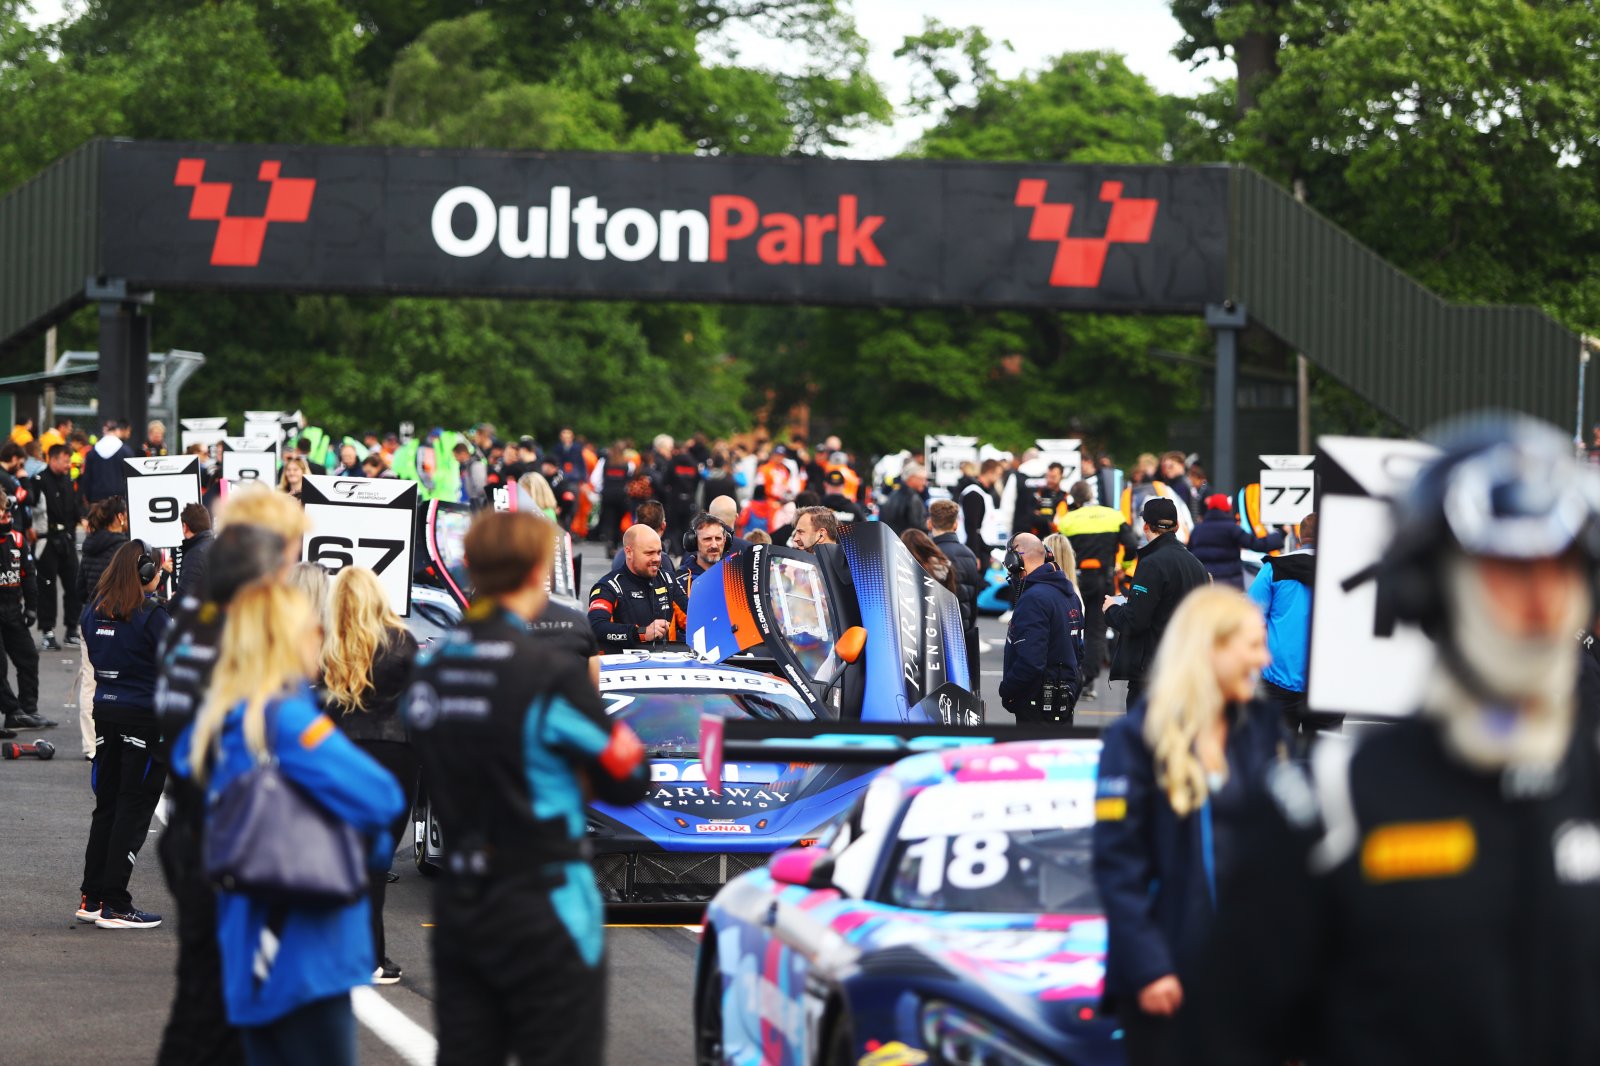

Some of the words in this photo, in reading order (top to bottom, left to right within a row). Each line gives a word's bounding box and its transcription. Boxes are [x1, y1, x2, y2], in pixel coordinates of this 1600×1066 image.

[148, 496, 179, 524] 9
[1264, 487, 1311, 505] 77
[307, 535, 406, 577] 67
[526, 621, 574, 631] ELSTAFF
[895, 540, 920, 692] PARKWA
[923, 575, 940, 671] ENGLAN
[645, 787, 790, 802] ARKWAY
[663, 799, 769, 808] ENGLAND
[907, 833, 1010, 895] 18
